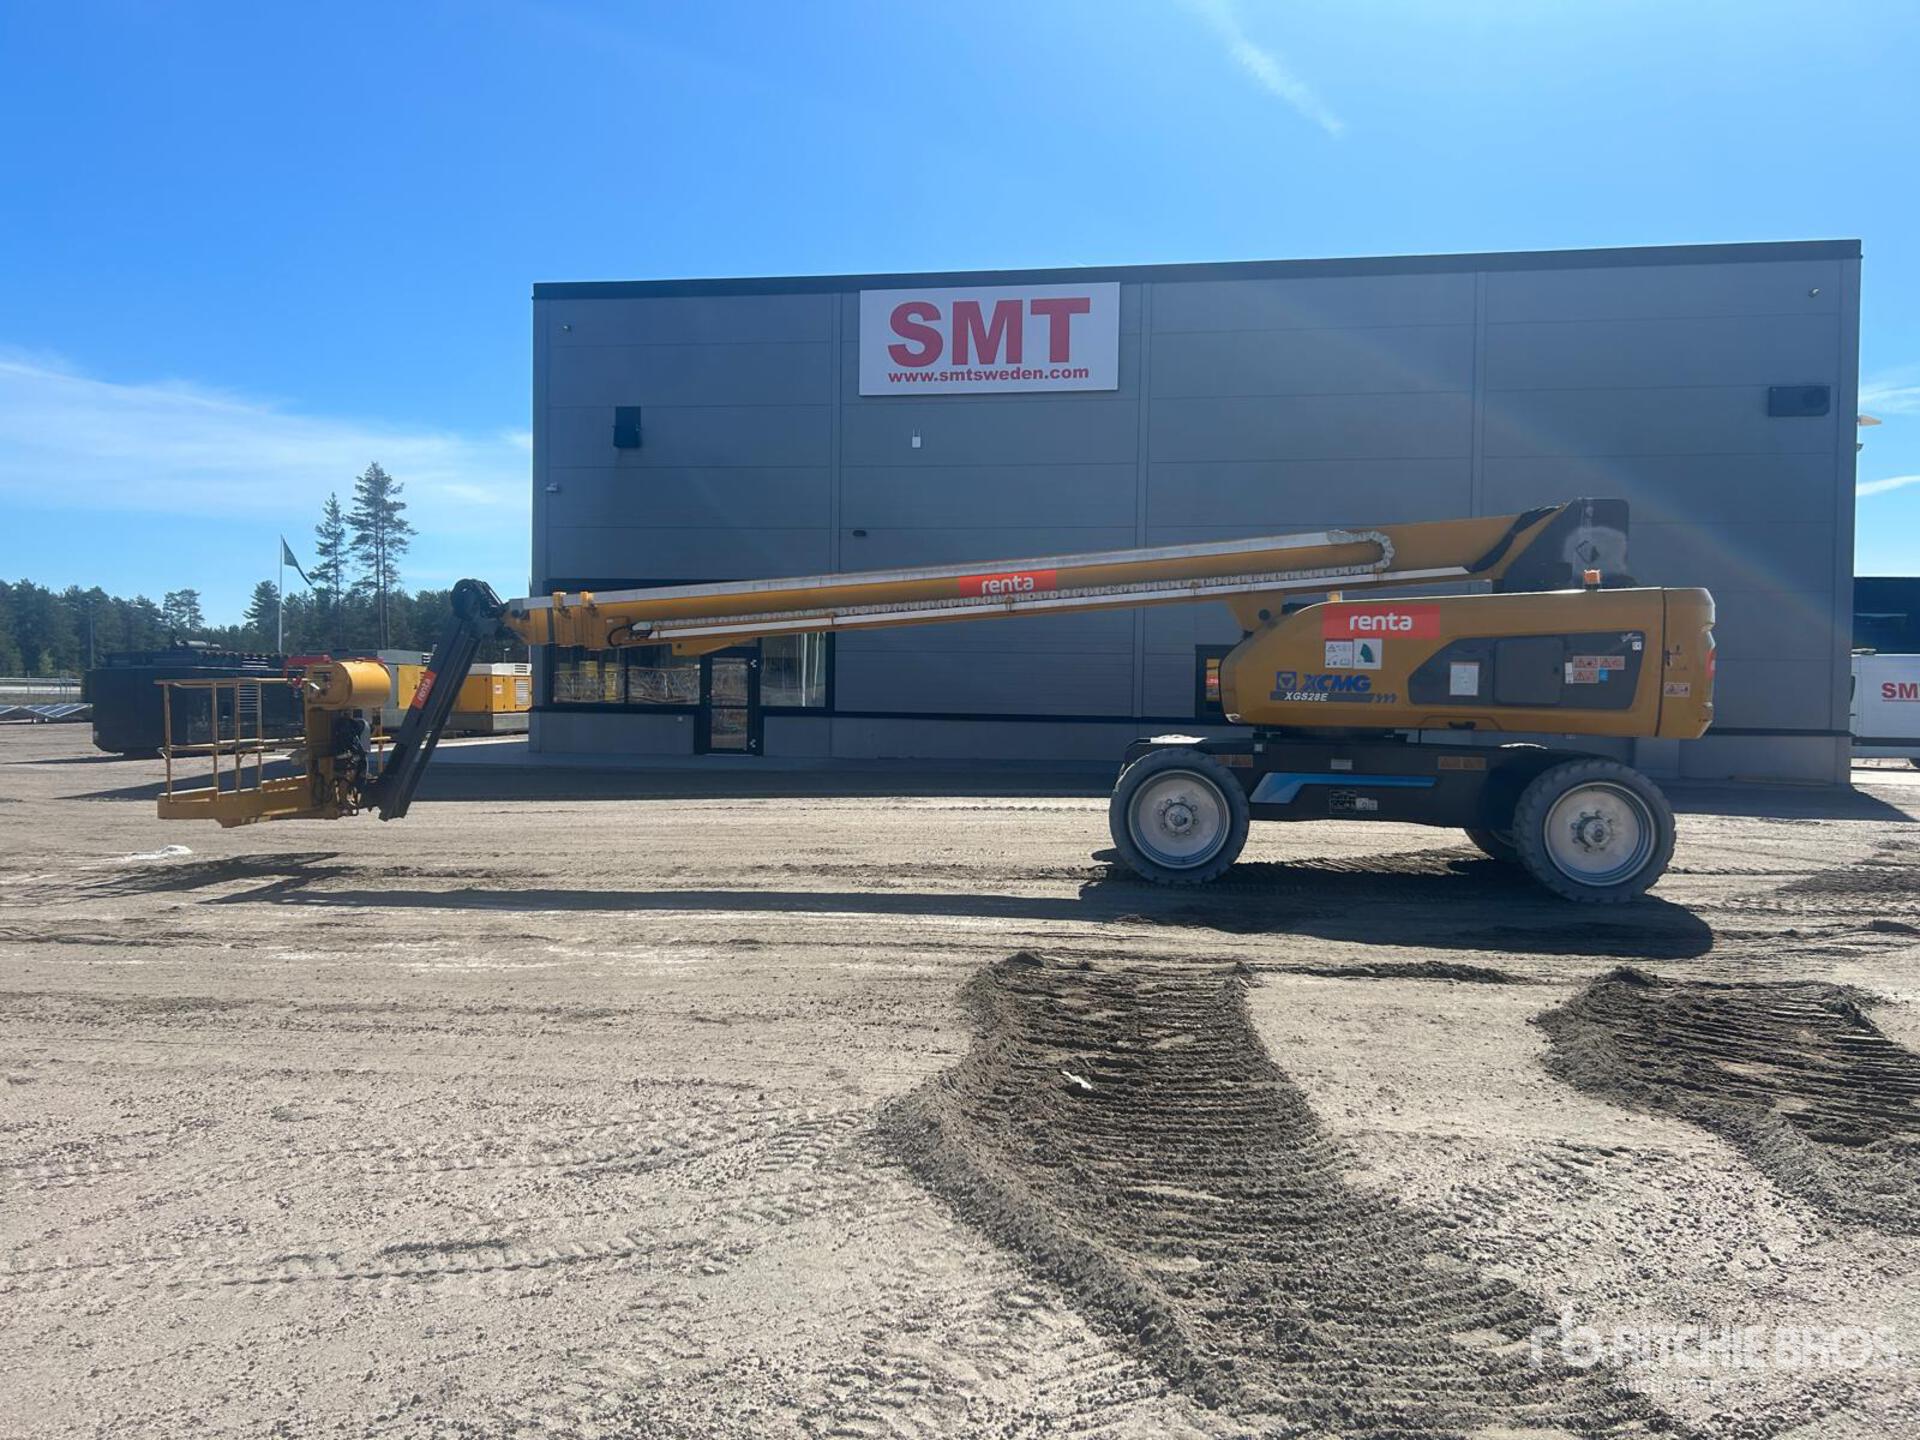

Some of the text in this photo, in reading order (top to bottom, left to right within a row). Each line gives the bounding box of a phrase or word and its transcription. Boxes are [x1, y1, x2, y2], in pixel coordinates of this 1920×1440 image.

[888, 297, 1090, 367] SMT
[888, 367, 1089, 383] www.smtsweden.com
[981, 575, 1034, 594] renta
[1350, 612, 1412, 631] renta
[1302, 673, 1372, 692] XCMG
[1881, 682, 1920, 699] SM
